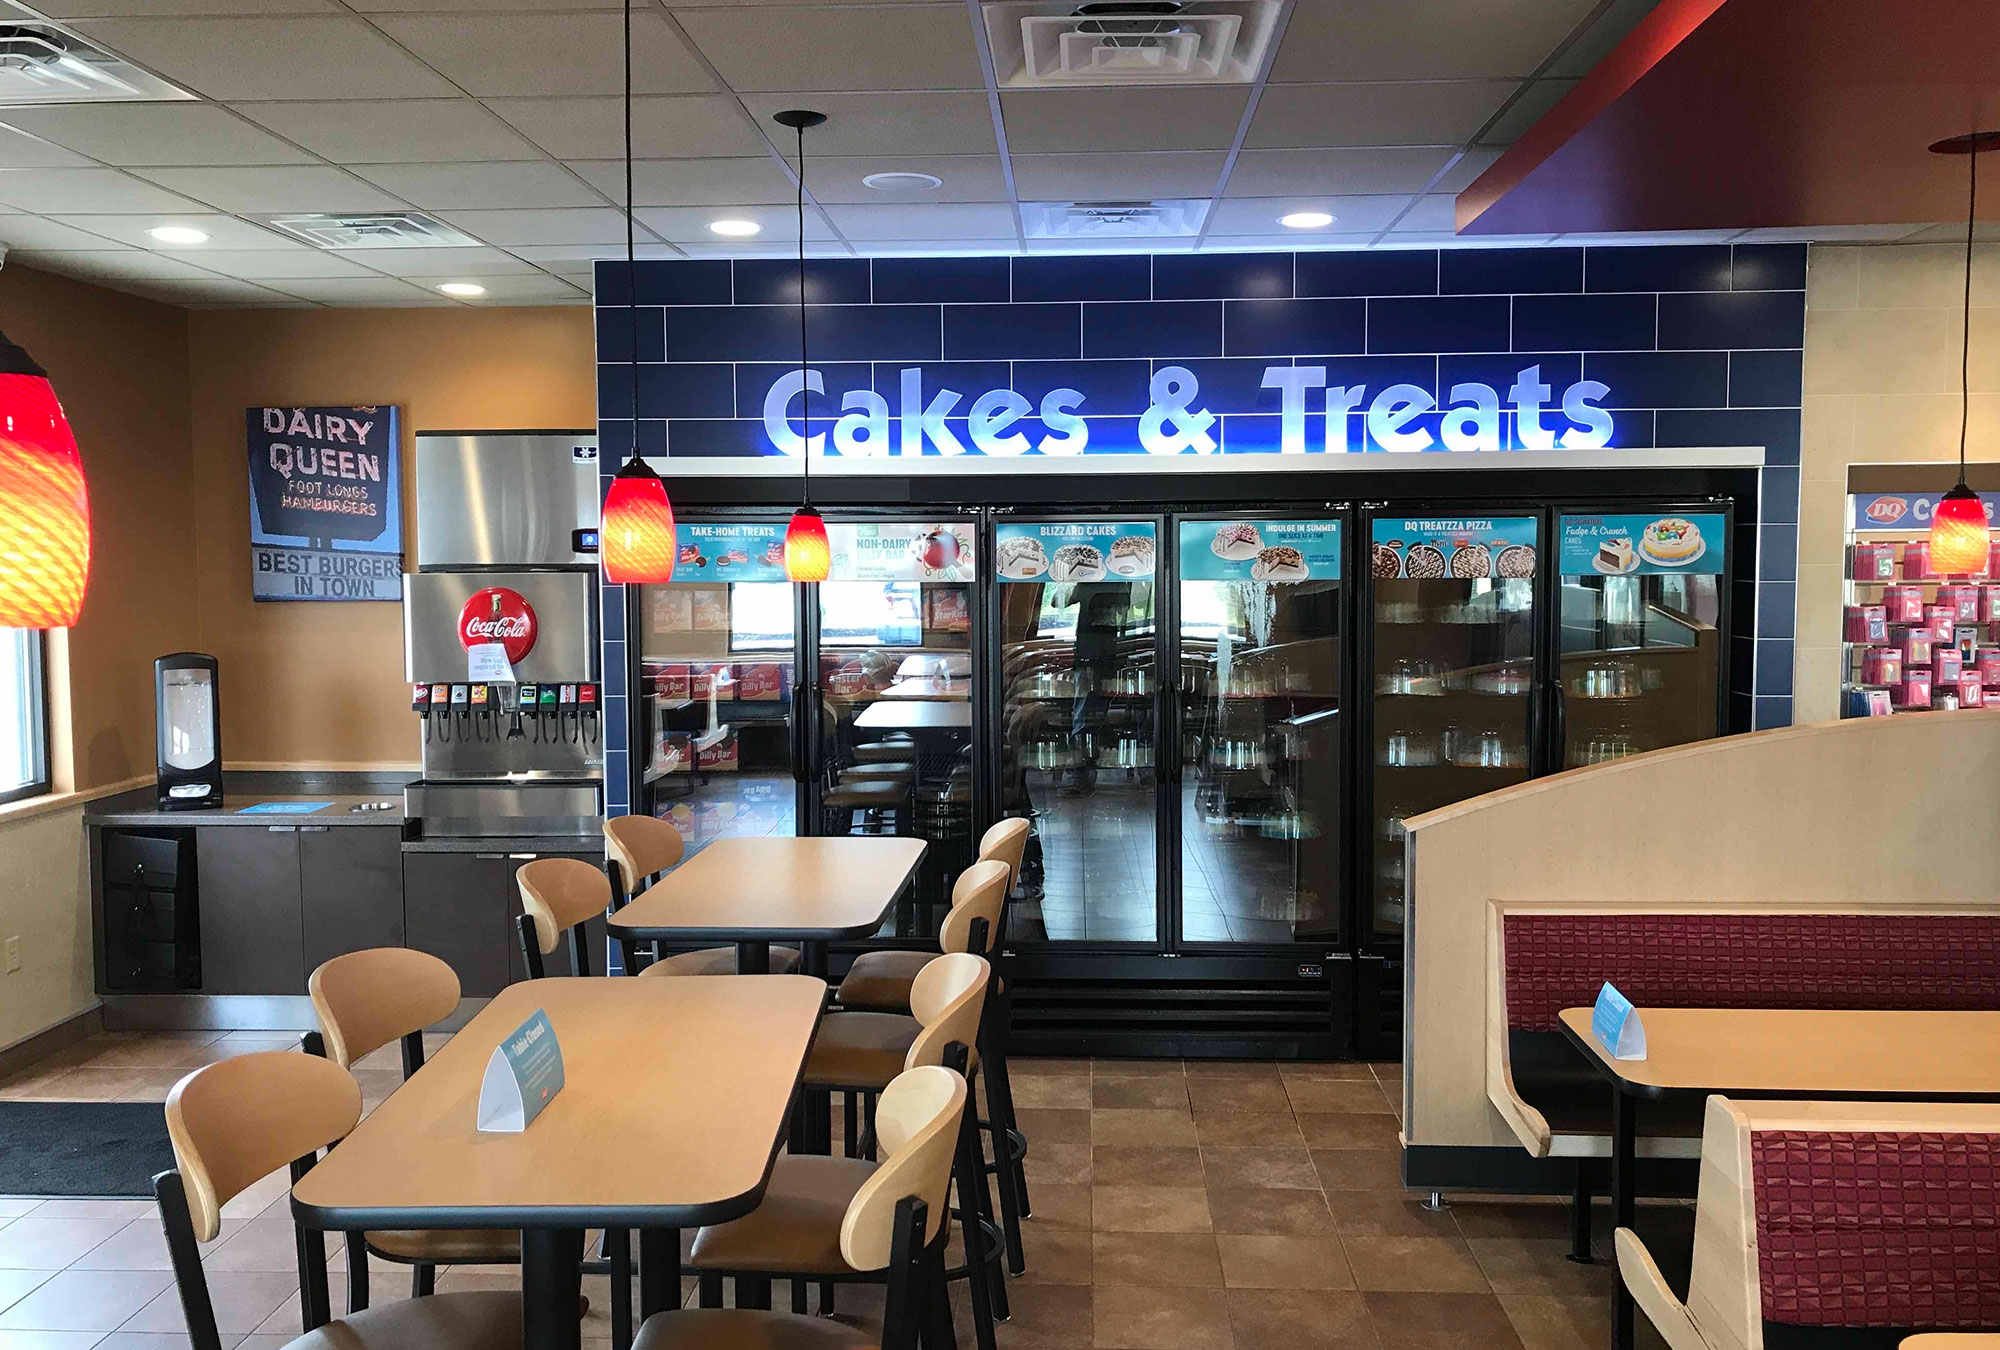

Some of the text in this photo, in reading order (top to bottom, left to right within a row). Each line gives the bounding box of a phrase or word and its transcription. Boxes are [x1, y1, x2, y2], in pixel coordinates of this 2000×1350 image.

[763, 363, 1615, 458] Cakes & Treats
[263, 407, 374, 445] DAIRY
[270, 443, 380, 482] QUEEN
[289, 480, 368, 499] FOOT LONGS
[282, 493, 377, 517] HAMBURGERS
[1873, 503, 1902, 517] DQ
[690, 526, 775, 537] TAKE-HOME TREATS
[1040, 526, 1117, 536] BLIZZARD CAKES
[1266, 524, 1337, 532] INDULGE IN SUMMER
[1405, 521, 1493, 531] DQ TREATZZA PIZZA
[1566, 526, 1628, 536] Fudge & Crunch
[856, 538, 911, 549] NON-DAIRY
[259, 552, 402, 578] BEST BURGERS
[294, 575, 375, 597] IN TOWN
[669, 681, 684, 691] Bar
[741, 680, 774, 693] Dilly Bar
[835, 683, 852, 694] Bar
[700, 748, 731, 761] Dilly Bar
[673, 822, 688, 831] Bar
[511, 1038, 529, 1057] Table
[526, 1019, 545, 1044] Closed
